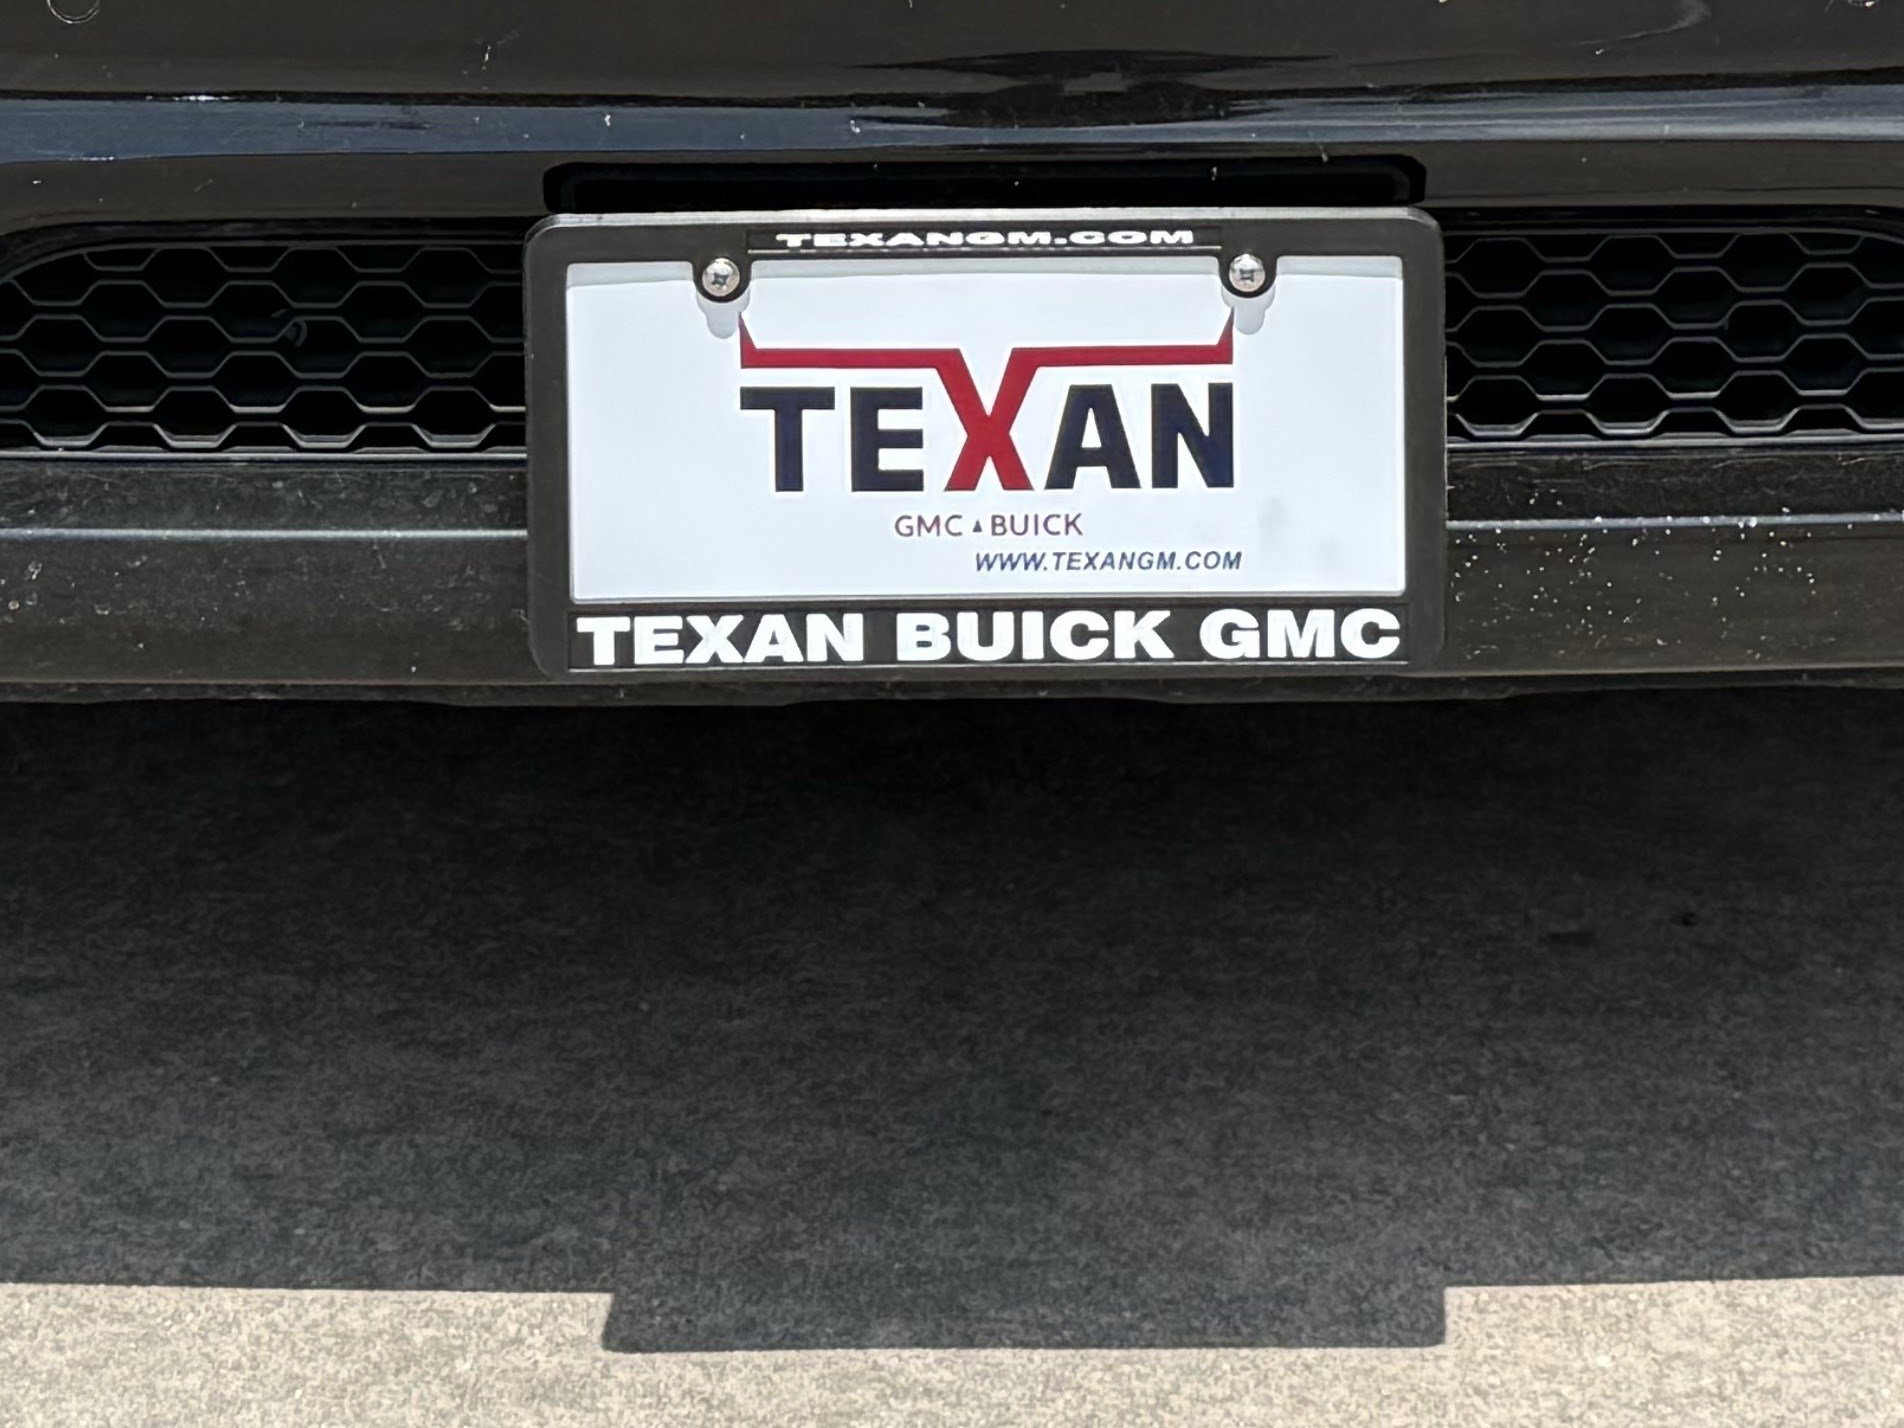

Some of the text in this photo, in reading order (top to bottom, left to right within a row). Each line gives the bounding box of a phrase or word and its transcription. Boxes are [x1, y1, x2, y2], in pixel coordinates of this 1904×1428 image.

[776, 230, 1194, 248] TEXANGM.COM
[739, 349, 1235, 492] TEXAN
[894, 513, 1083, 538] GMC BUICK
[975, 550, 1243, 572] WWW.TEXANGM.COM
[577, 608, 1402, 666] TEXAN BUICK GMC
